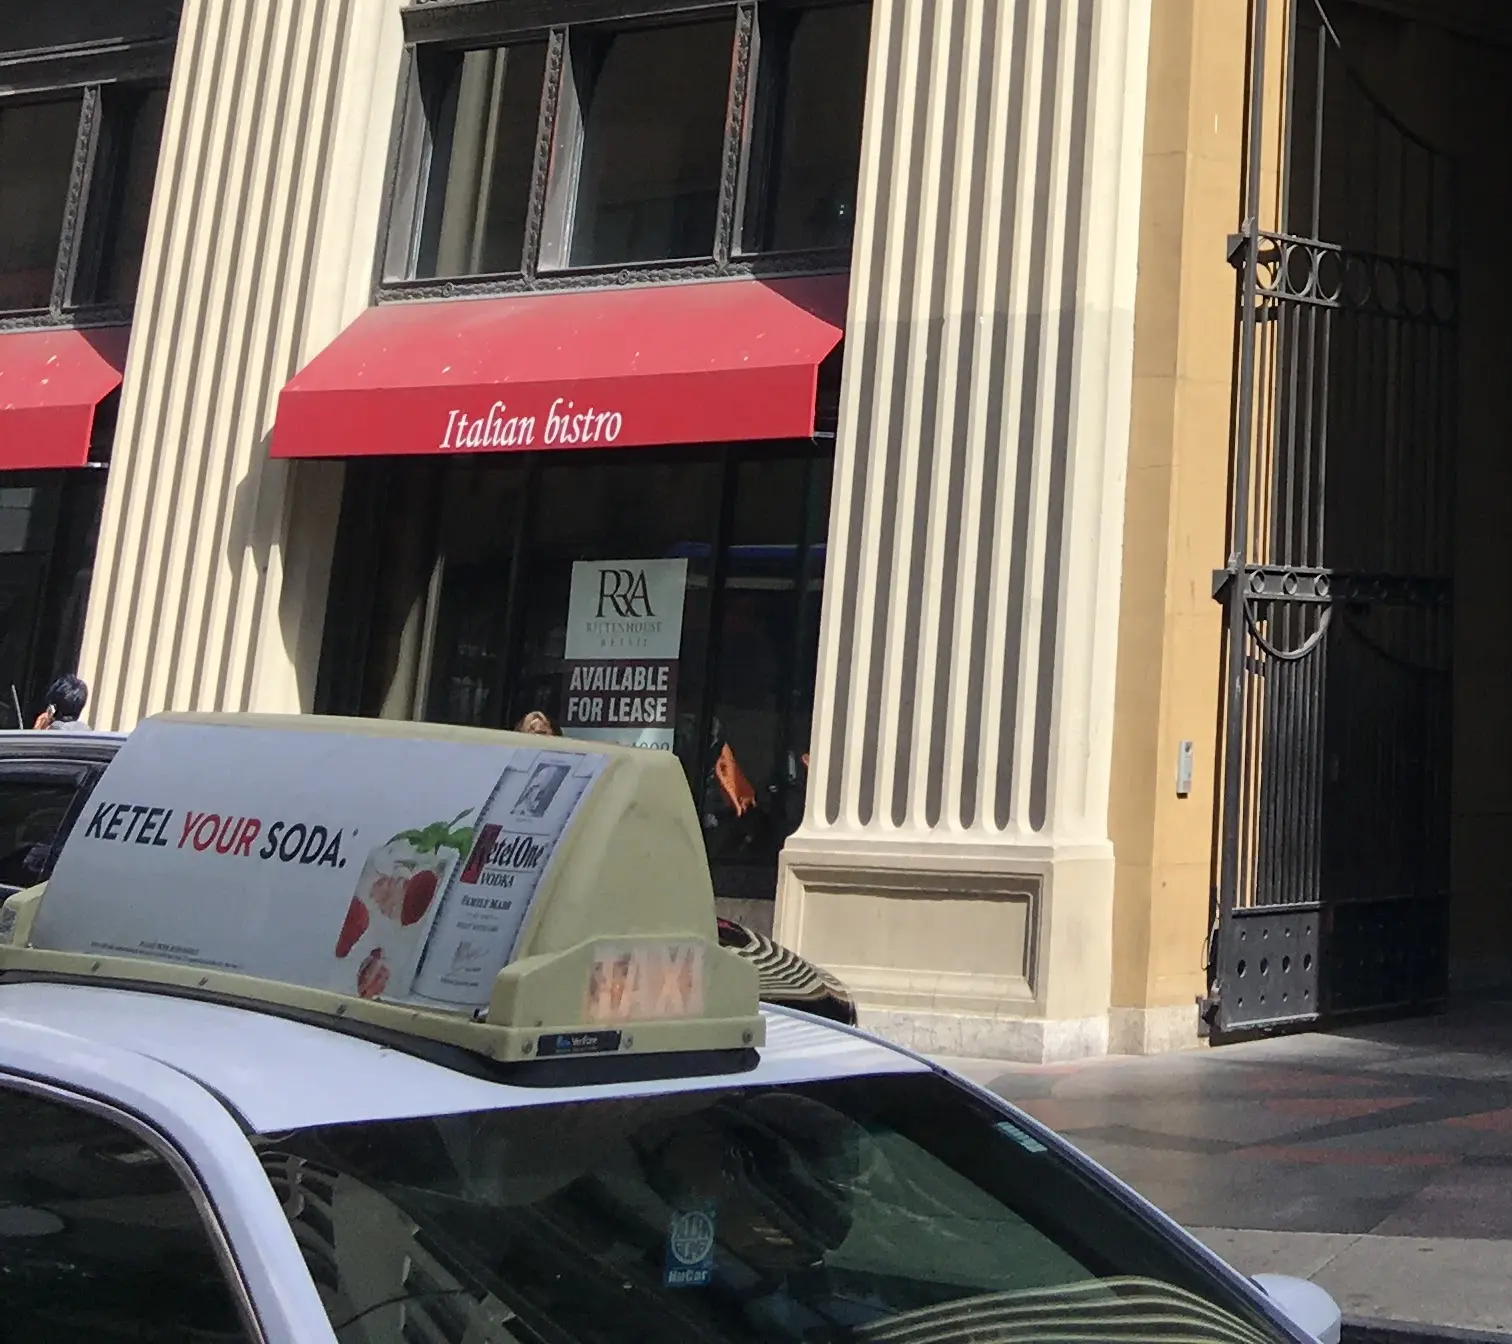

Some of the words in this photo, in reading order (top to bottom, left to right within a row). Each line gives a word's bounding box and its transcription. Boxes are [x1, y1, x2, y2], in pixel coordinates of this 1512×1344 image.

[440, 400, 536, 449] Italian
[544, 397, 622, 444] bistro
[569, 666, 669, 691] AVAILABLE
[567, 697, 602, 722] FOR
[608, 697, 668, 723] LEASE
[85, 802, 173, 846] KETEL
[177, 811, 261, 857] YOUR
[260, 821, 346, 868] SODA.
[480, 872, 515, 888] VODKA
